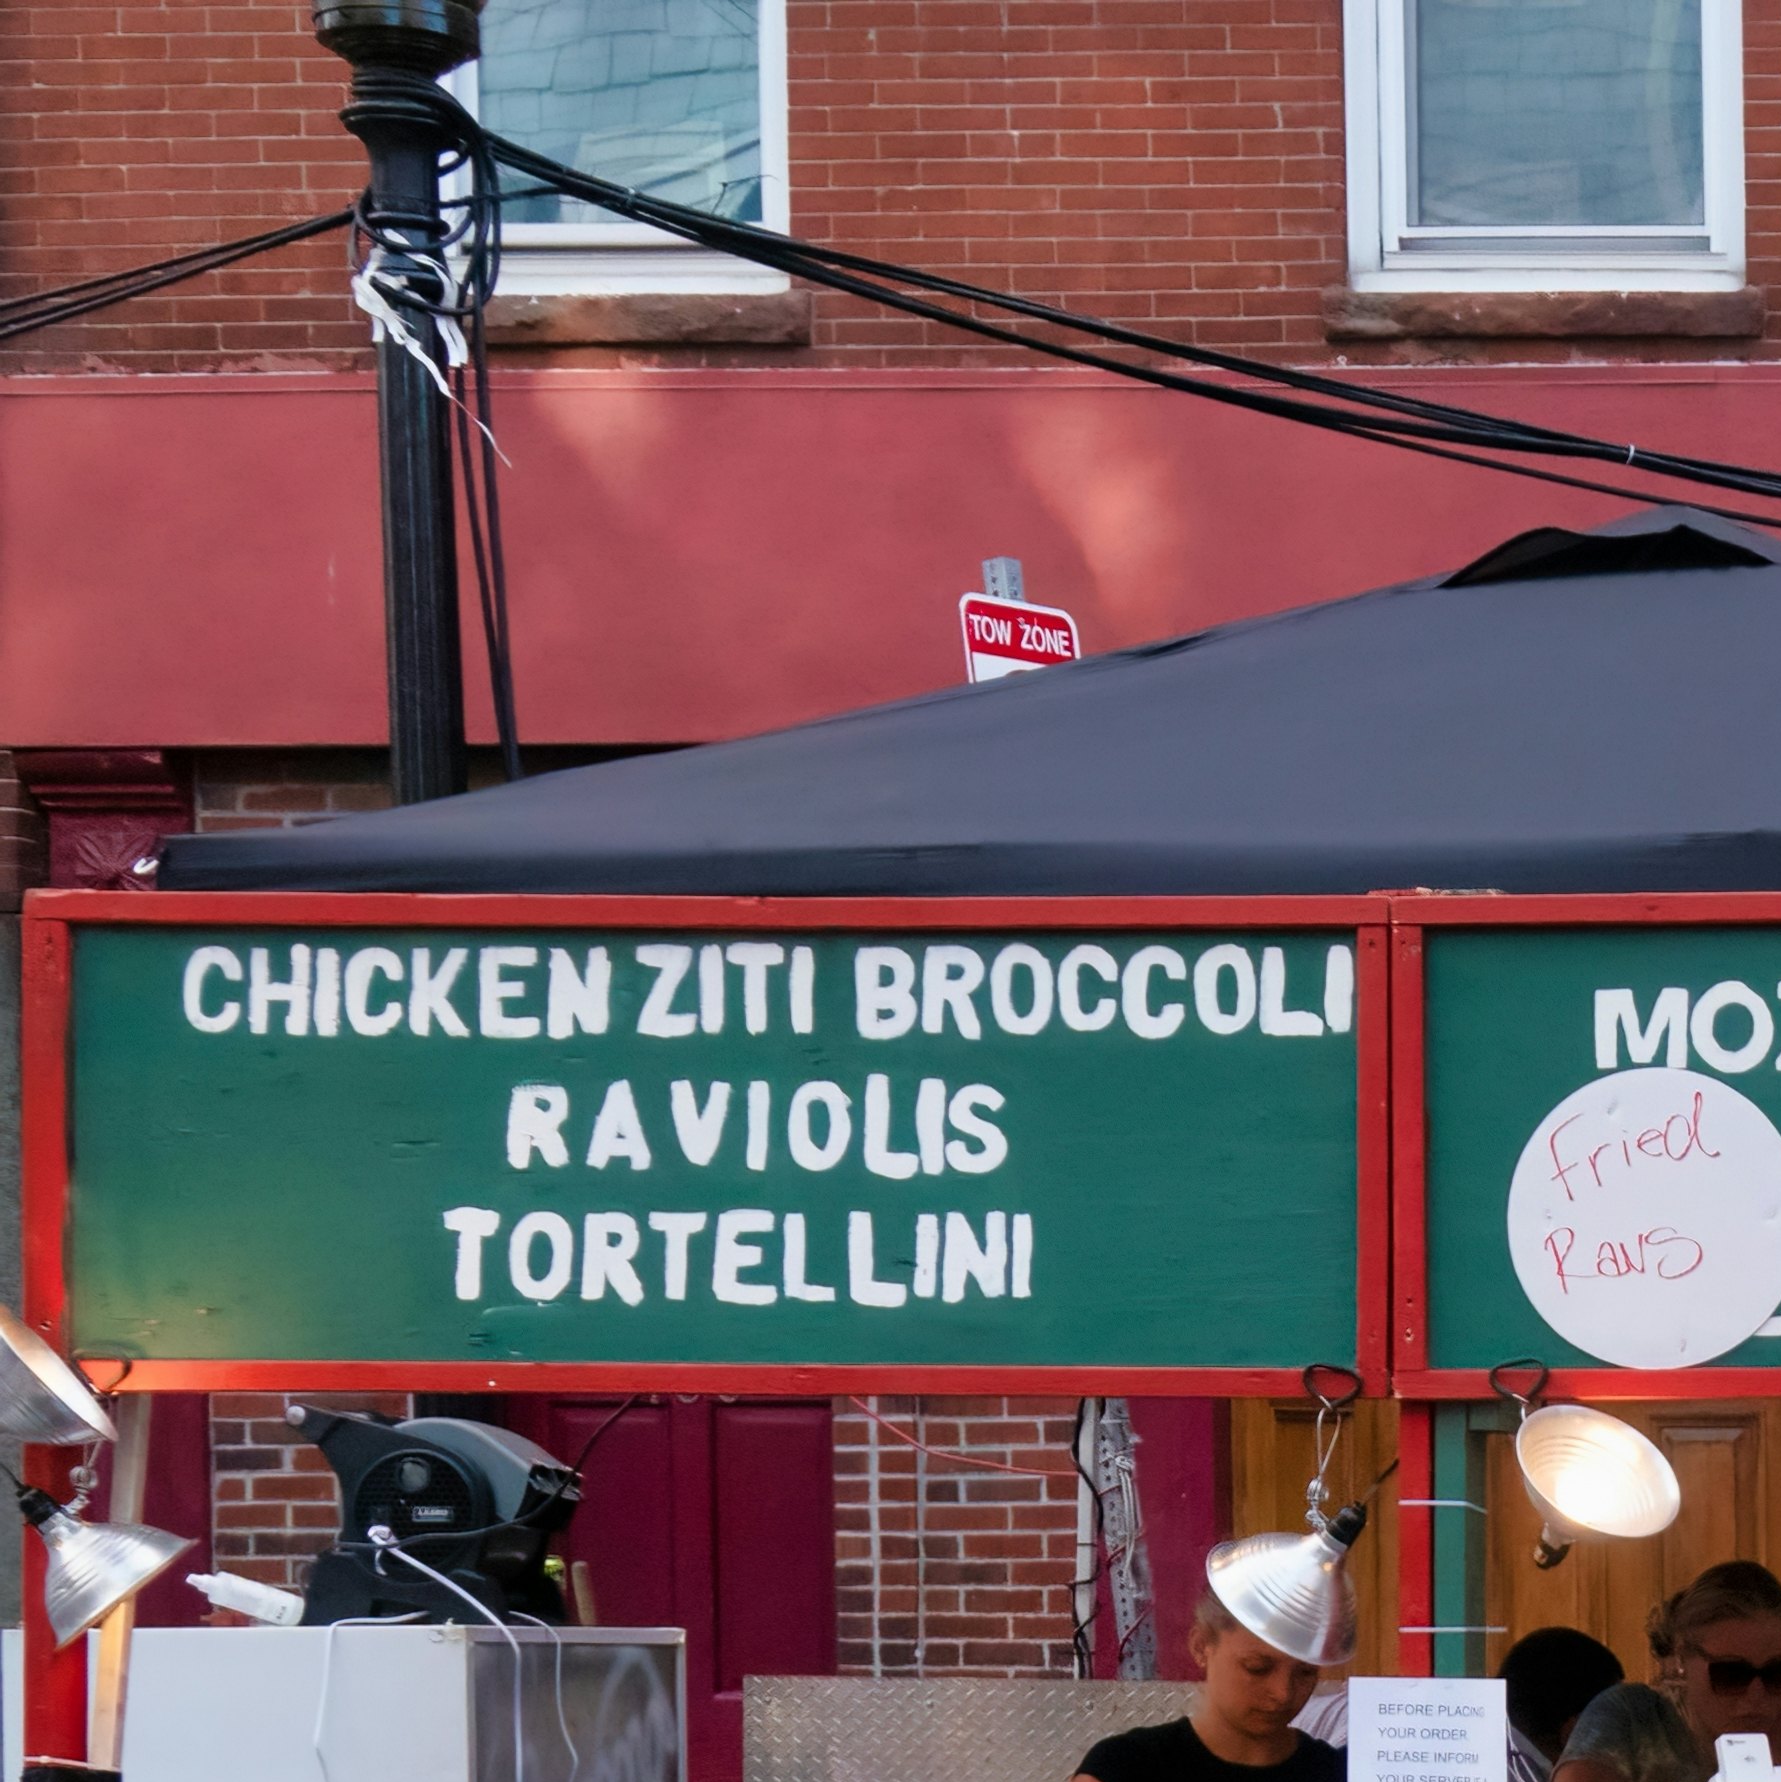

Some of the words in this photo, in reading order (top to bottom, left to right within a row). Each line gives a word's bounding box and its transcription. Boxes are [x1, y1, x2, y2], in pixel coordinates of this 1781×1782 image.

[969, 613, 1011, 646] TOW
[1020, 624, 1072, 657] ZONE
[184, 943, 609, 1039] CHICKEN
[637, 943, 816, 1035] ZITI
[855, 942, 1354, 1040] BROCCOLI
[507, 1074, 1006, 1179] RAVIOLIS
[1550, 1091, 1720, 1201] Fried
[443, 1205, 1033, 1307] TORTELLINI
[1378, 1704, 1433, 1716] BEFORE
[1438, 1705, 1486, 1718] PLACING
[1378, 1727, 1416, 1739] YOUR
[1377, 1751, 1429, 1763] PLEASE
[1434, 1752, 1479, 1764] INFORM
